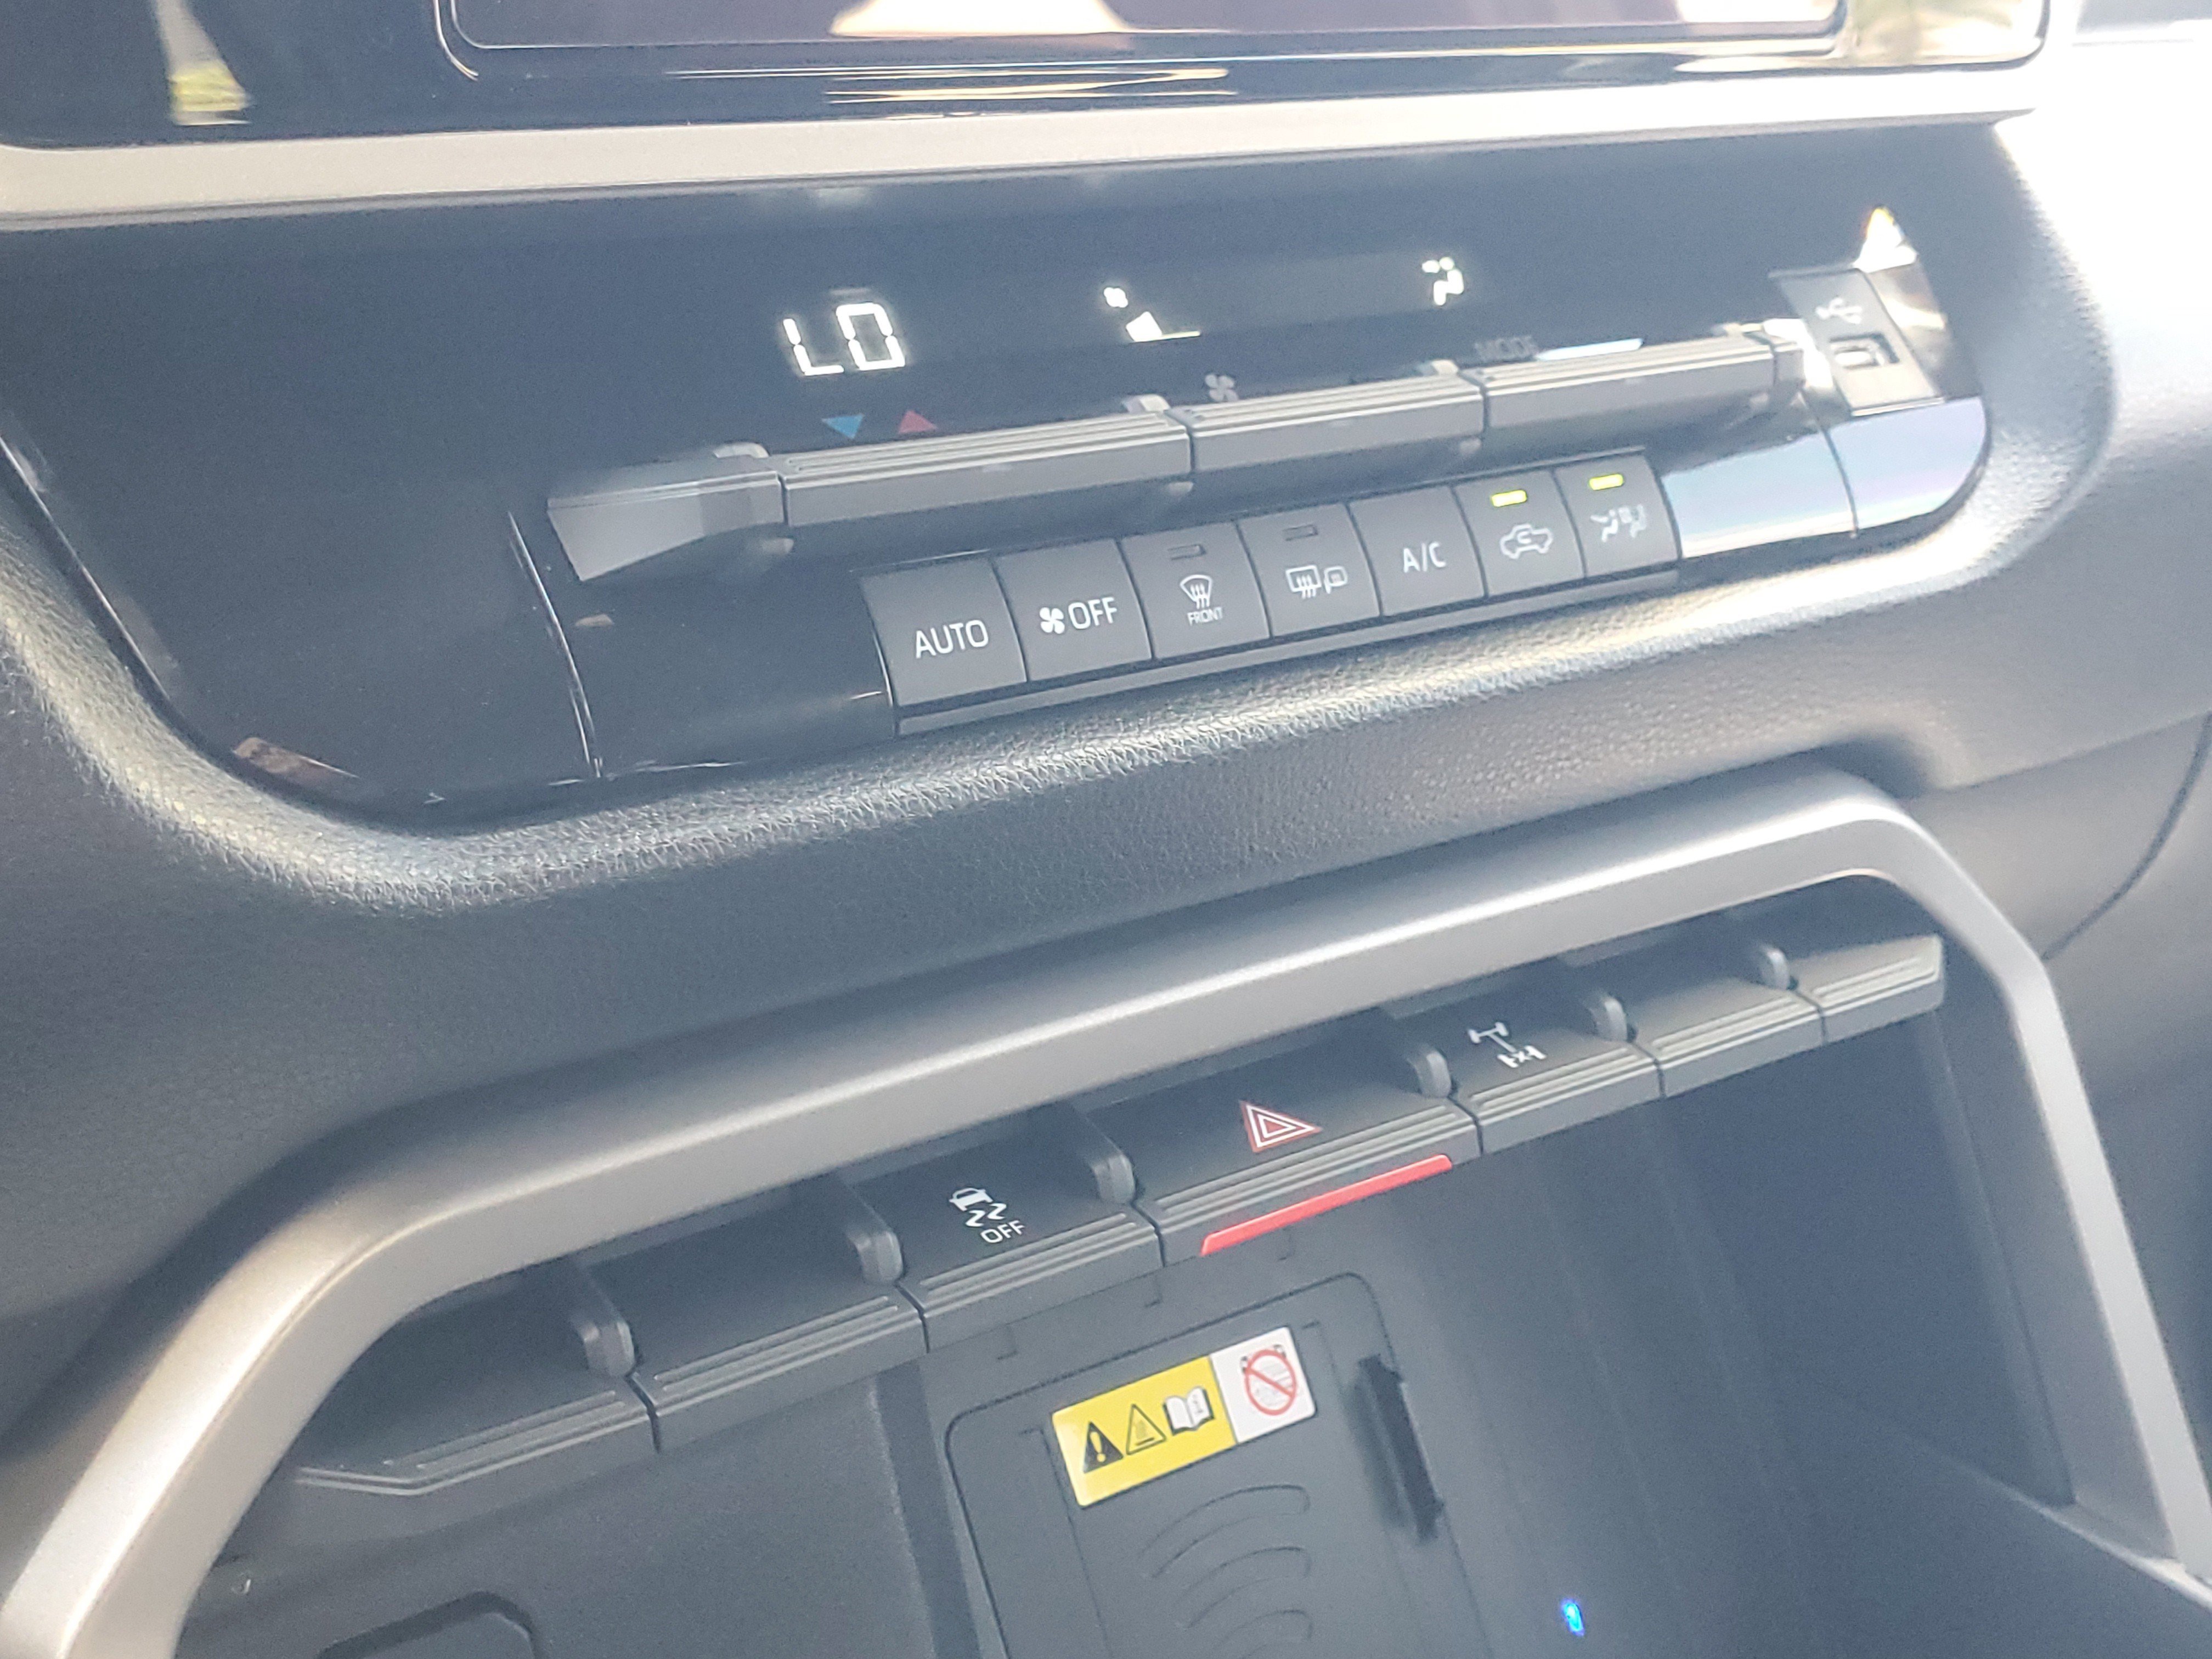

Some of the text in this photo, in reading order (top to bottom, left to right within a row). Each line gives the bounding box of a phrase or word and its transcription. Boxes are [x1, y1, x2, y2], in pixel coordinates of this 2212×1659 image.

[1403, 542, 1447, 573] A/C
[1068, 596, 1118, 630] OFF
[1187, 607, 1223, 626] FRONT
[915, 619, 989, 658] AUTO
[980, 1220, 1025, 1244] OFF
